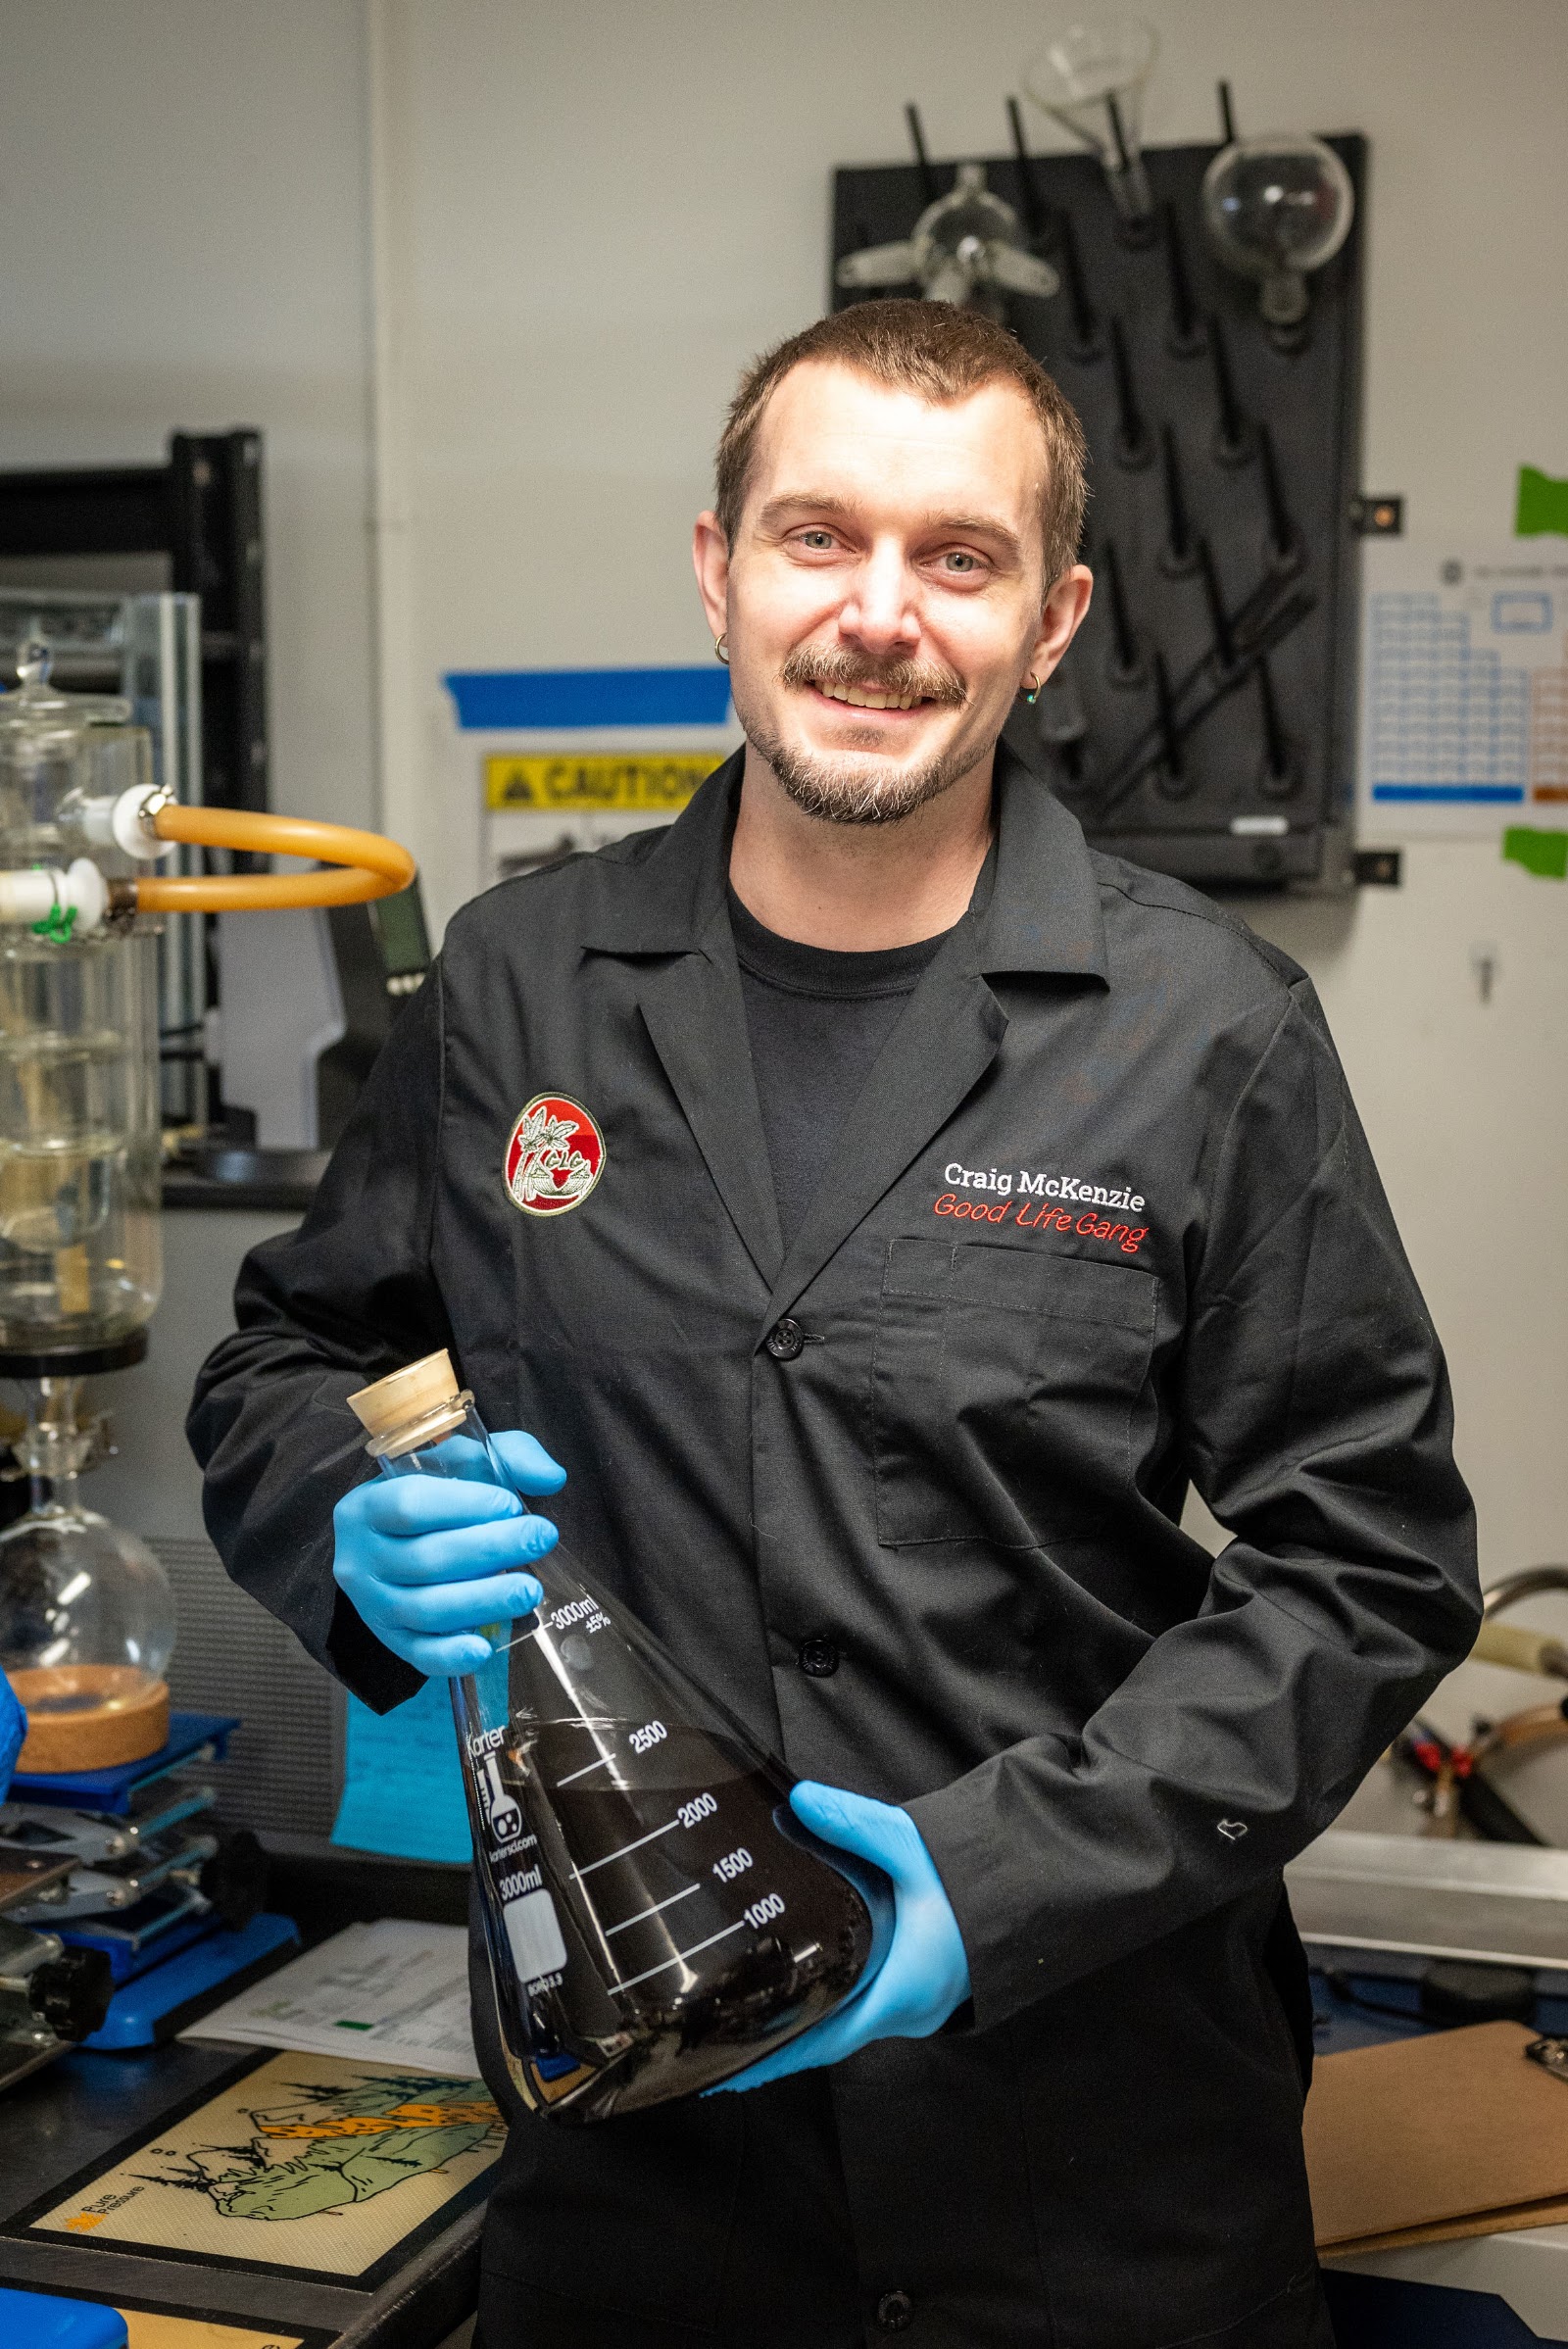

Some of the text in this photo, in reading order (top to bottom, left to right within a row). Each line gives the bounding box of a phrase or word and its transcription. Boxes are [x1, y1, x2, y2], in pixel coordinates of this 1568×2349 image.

[944, 1163, 1146, 1212] Craig McKenzie
[934, 1193, 1150, 1253] Good Life Gang
[550, 1593, 600, 1630] 3000ml
[585, 1611, 612, 1634] ±5%
[466, 1725, 506, 1758] Karter
[628, 1720, 668, 1754] 2500
[677, 1792, 718, 1829] 2000
[500, 1864, 542, 1901] 3000ml
[711, 1847, 754, 1884] 1500
[743, 1892, 785, 1930] 1000
[80, 2194, 117, 2213] Pure
[97, 2185, 145, 2215] Pressure
